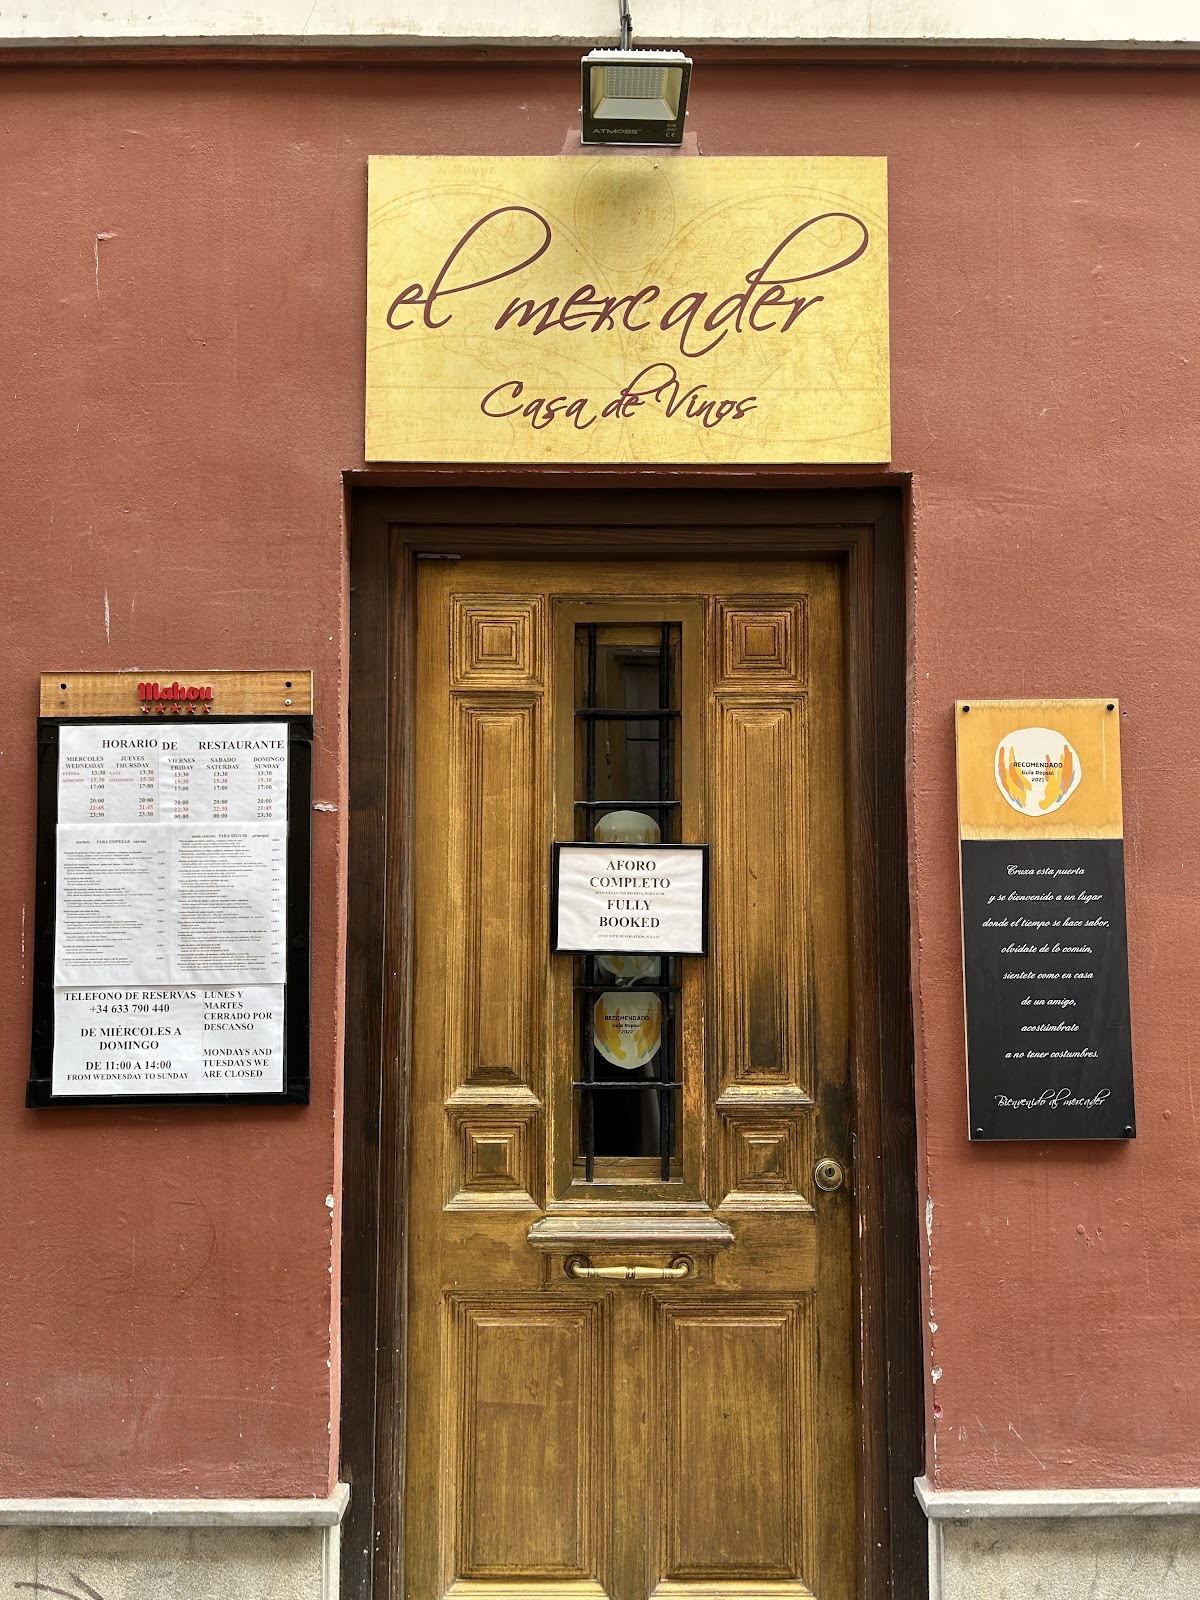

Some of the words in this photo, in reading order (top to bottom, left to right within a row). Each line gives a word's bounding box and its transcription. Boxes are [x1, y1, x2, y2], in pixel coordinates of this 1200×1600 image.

[386, 206, 552, 330] el
[494, 212, 869, 358] mercader
[480, 381, 596, 430] Casa
[601, 363, 676, 418] de
[656, 382, 758, 428] Vinos
[138, 682, 212, 700] Mahou
[102, 739, 158, 748] HORARIO
[162, 742, 178, 750] DE
[199, 740, 285, 750] RESTAURANTE
[606, 860, 656, 871] AFORO
[1006, 864, 1035, 875] Cruza
[1053, 867, 1085, 878] puerta
[590, 877, 670, 888] COMPLETO
[987, 895, 996, 904] y
[1008, 891, 1054, 901] bienvenido
[1077, 890, 1102, 904] lugar
[607, 900, 652, 910] FULLY
[599, 916, 660, 928] BOOKED
[982, 918, 1008, 927] donde
[1010, 917, 1022, 927] el
[1021, 919, 1050, 930] tiempo
[1062, 917, 1083, 927] hace
[1084, 917, 1110, 928] sabor,
[1039, 944, 1050, 953] de
[1052, 943, 1060, 953] lo
[64, 992, 123, 1001] TELEFONO
[125, 992, 140, 1000] DE
[142, 991, 196, 1000] RESERVAS
[1021, 996, 1032, 1006] de
[1047, 998, 1077, 1008] amigo,
[90, 1005, 108, 1014] +34
[111, 1004, 129, 1013] 633
[132, 1004, 149, 1013] 790
[152, 1004, 170, 1013] 440
[80, 1028, 96, 1037] DE
[100, 1025, 171, 1036] MIÉRCOLES
[173, 1027, 182, 1036] A
[204, 1023, 254, 1031] DESCANSO
[1021, 1021, 1079, 1032] acostúmbrate
[99, 1041, 159, 1050] DOMINGO
[1027, 1050, 1049, 1058] tener
[1050, 1048, 1099, 1058] costumbres.
[86, 1062, 101, 1070] DE
[105, 1061, 131, 1070] 11:00
[133, 1061, 142, 1070] A
[145, 1061, 172, 1069] 14:00
[203, 1059, 252, 1067] TUESDAYS
[995, 1089, 1055, 1109] Bienvenido
[1049, 1088, 1071, 1109] al
[1063, 1089, 1111, 1109] mercader
